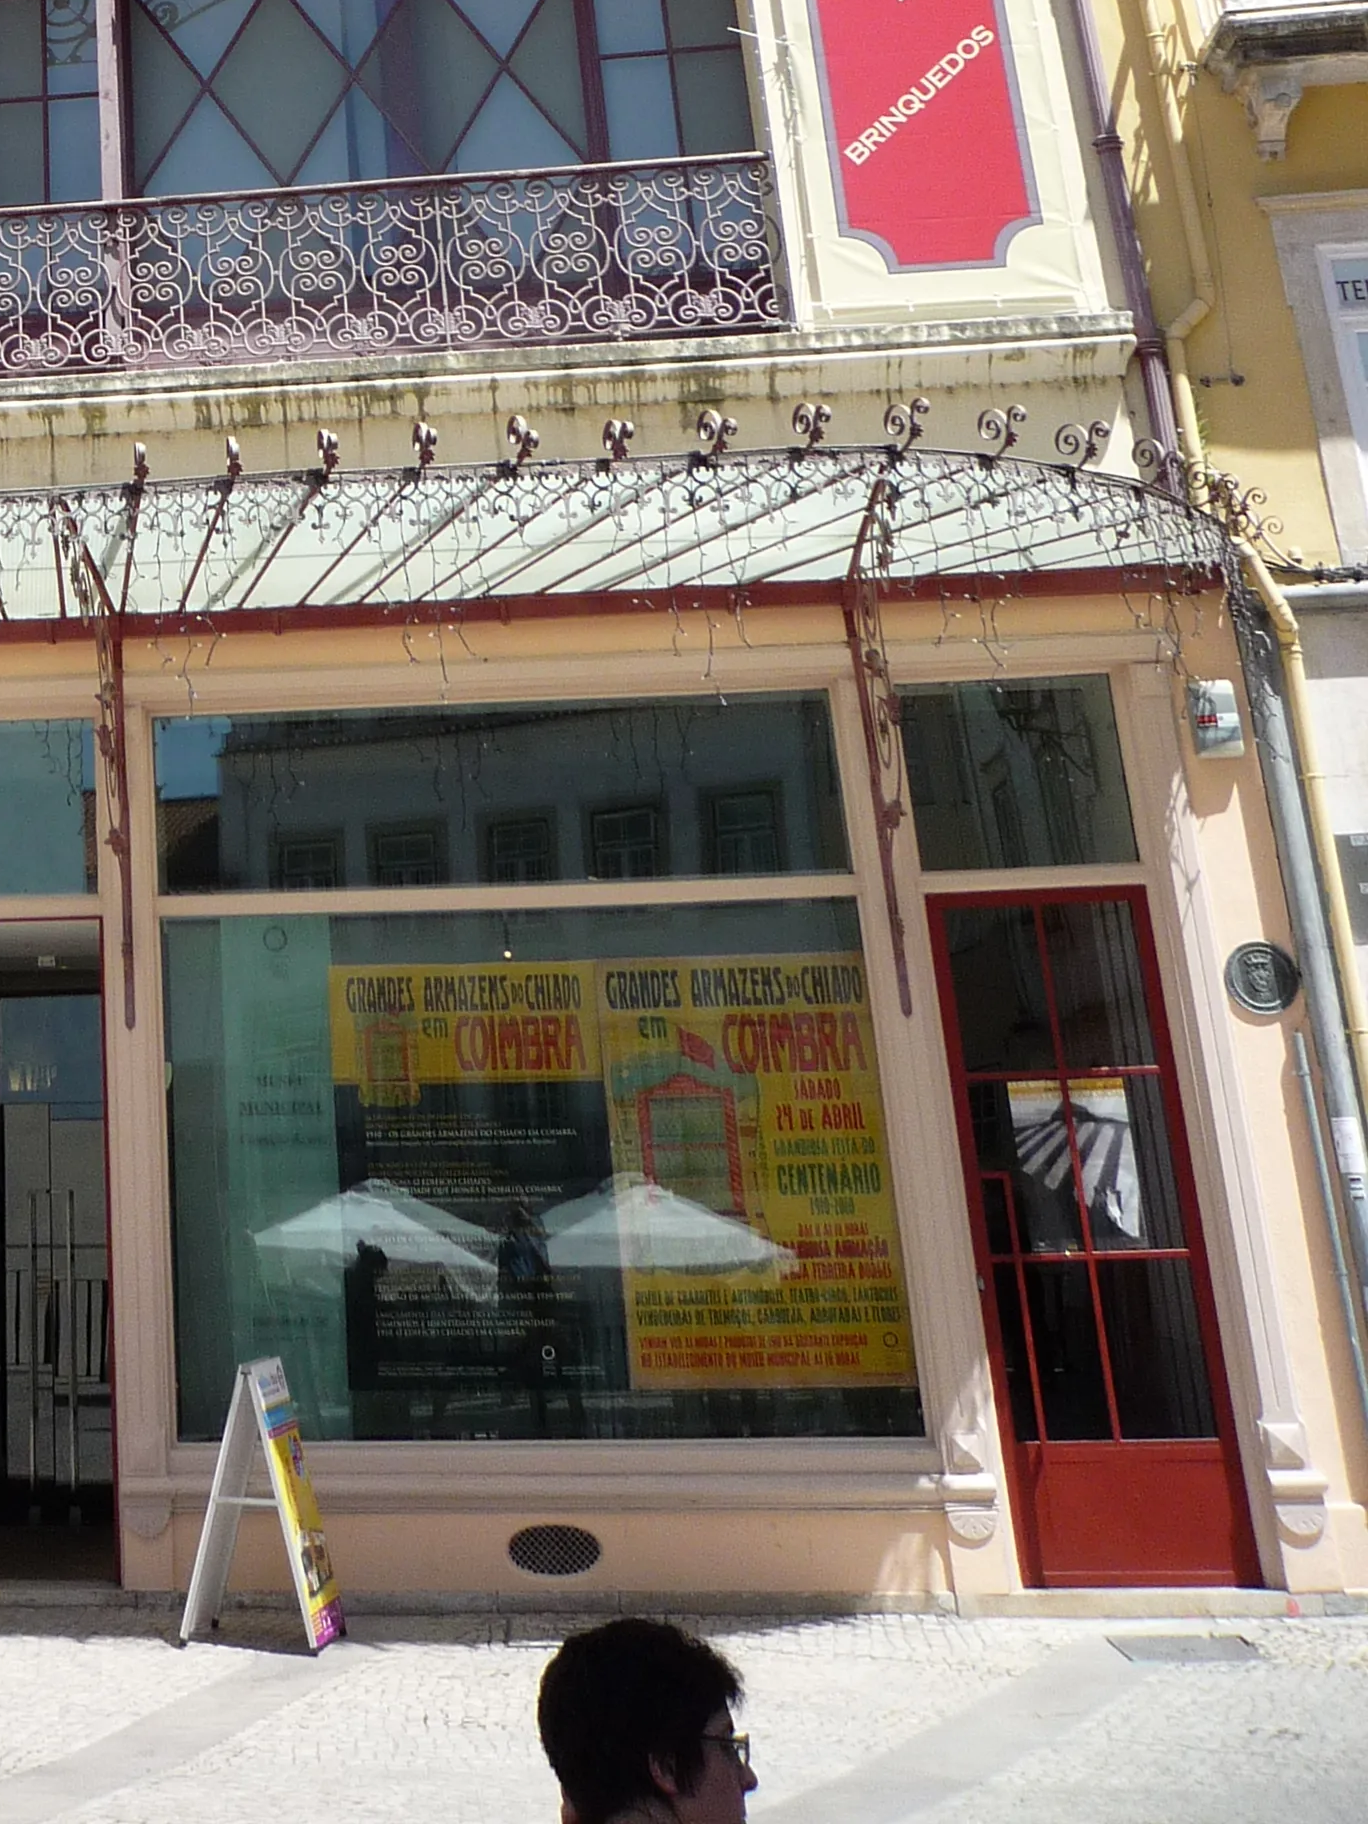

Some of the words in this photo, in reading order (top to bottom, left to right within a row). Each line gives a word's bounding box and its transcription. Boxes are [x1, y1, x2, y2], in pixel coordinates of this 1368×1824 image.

[844, 25, 995, 166] BRINQUEDOS
[1335, 279, 1368, 301] TE
[346, 977, 415, 1013] GRANDES
[423, 975, 510, 1012] ARMAZENS
[525, 974, 581, 1011] CHIADO
[606, 970, 681, 1010] GRANDES
[691, 966, 783, 1007] ARMAZENS
[801, 965, 863, 1004] CHIADO
[454, 1015, 587, 1071] COIMBRA
[722, 1011, 867, 1073] COIMBRA
[822, 1102, 866, 1130] ABRIL
[777, 1157, 881, 1195] CENTENÁRIO
